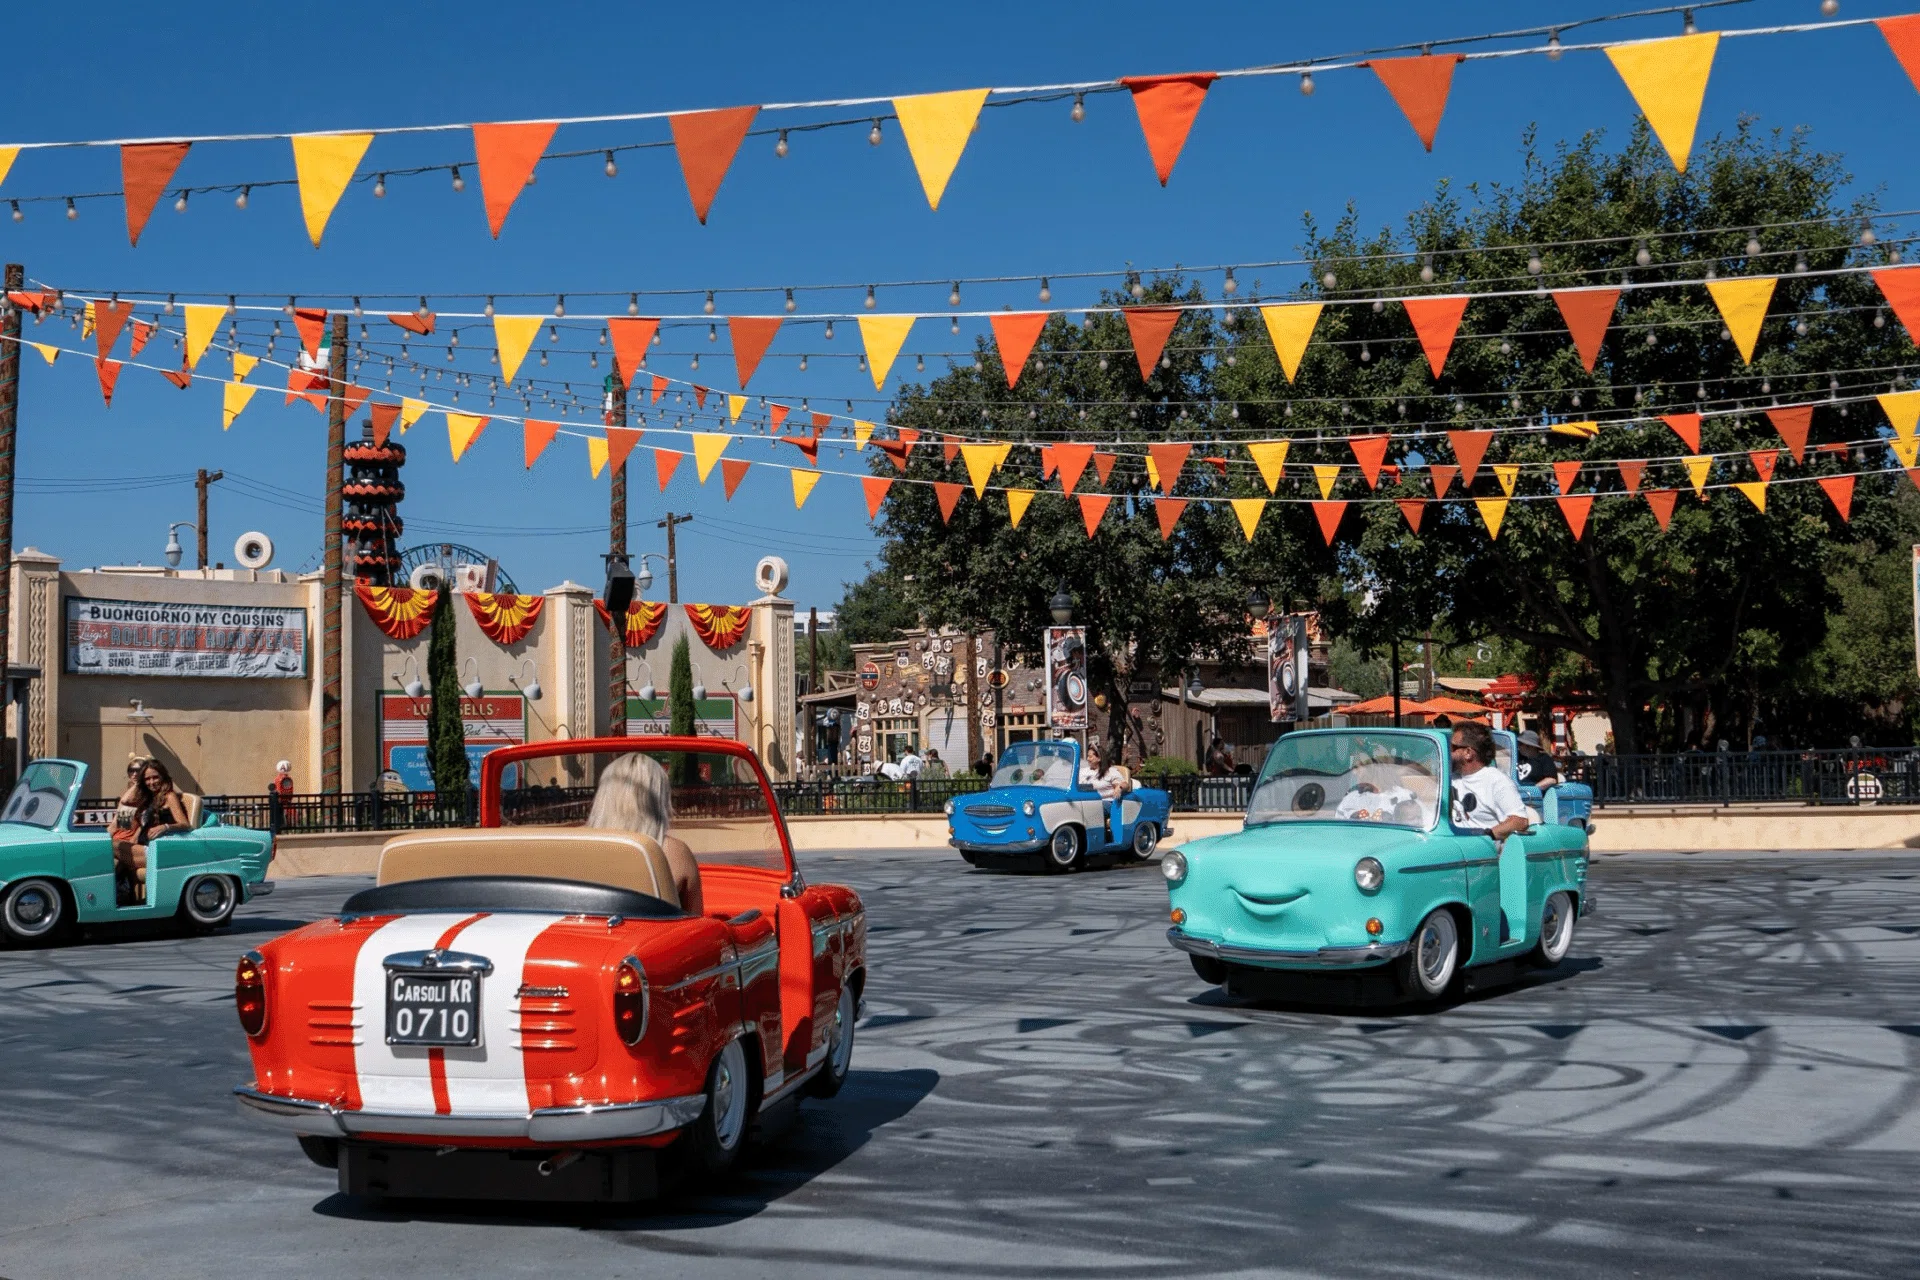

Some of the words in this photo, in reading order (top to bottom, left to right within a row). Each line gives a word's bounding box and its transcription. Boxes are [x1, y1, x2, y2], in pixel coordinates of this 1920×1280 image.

[91, 606, 191, 623] BUONGIORNO
[195, 612, 217, 625] MY
[222, 612, 284, 626] COUSINS
[79, 623, 109, 643] Luigi's
[111, 626, 201, 648] ROLLICKIN'
[206, 629, 294, 649] ROADSTERS
[108, 658, 134, 667] SING!
[138, 658, 171, 669] CELEBRATE!
[923, 656, 934, 668] 66
[858, 707, 868, 718] 66
[890, 703, 901, 715] 66
[983, 715, 994, 724] 66
[643, 723, 662, 734] CASA
[860, 741, 869, 751] 66
[84, 812, 113, 824] EXI
[450, 978, 472, 1003] KR
[396, 1007, 469, 1038] 0710
